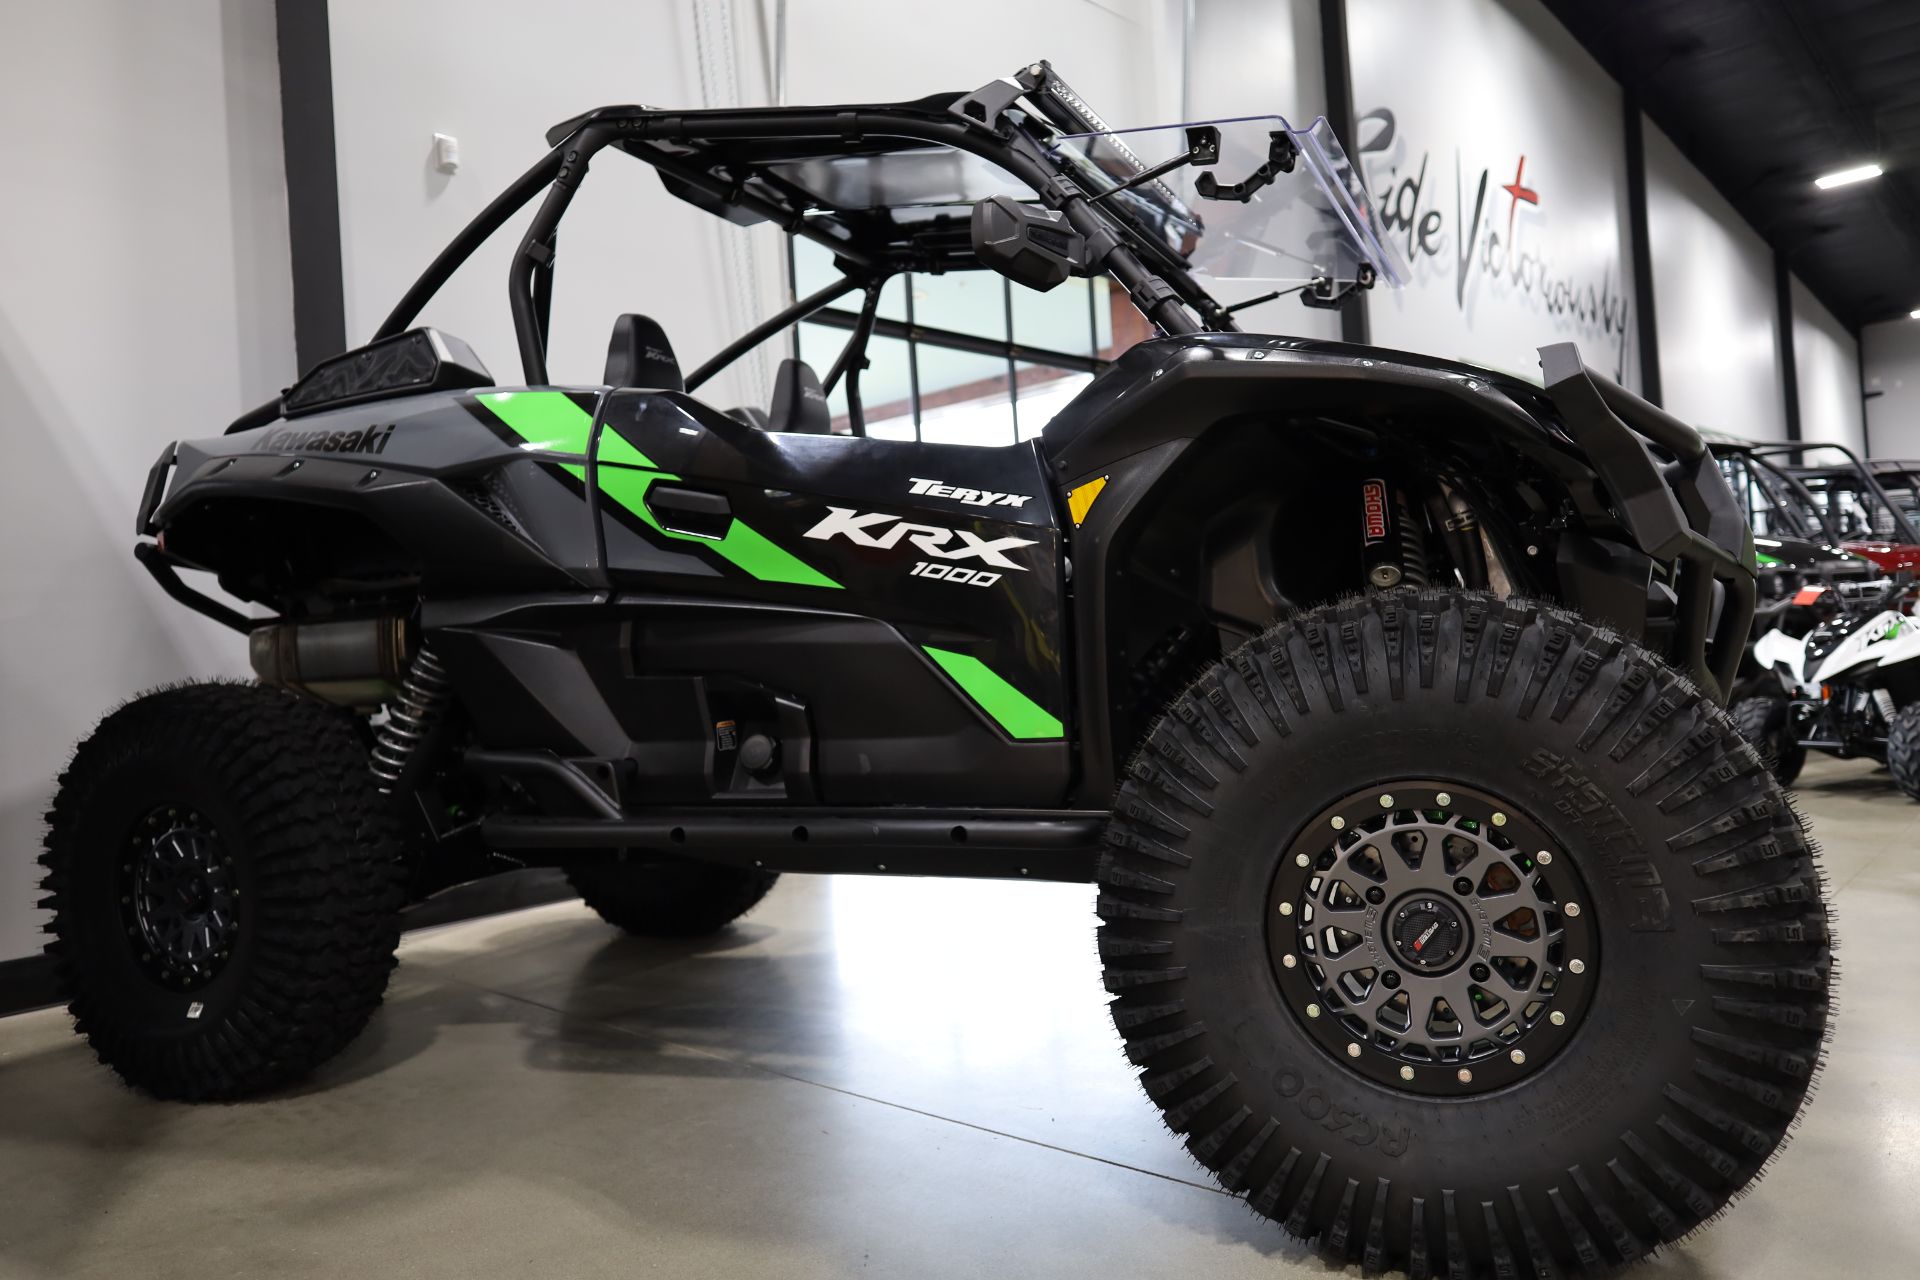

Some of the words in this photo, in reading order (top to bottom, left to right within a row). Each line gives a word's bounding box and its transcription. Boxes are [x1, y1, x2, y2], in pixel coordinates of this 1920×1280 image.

[250, 424, 396, 454] Kawasaki
[908, 477, 1033, 507] TERYX
[1364, 484, 1385, 538] SHOWA
[802, 506, 1040, 571] KRX
[910, 561, 1002, 587] 1000
